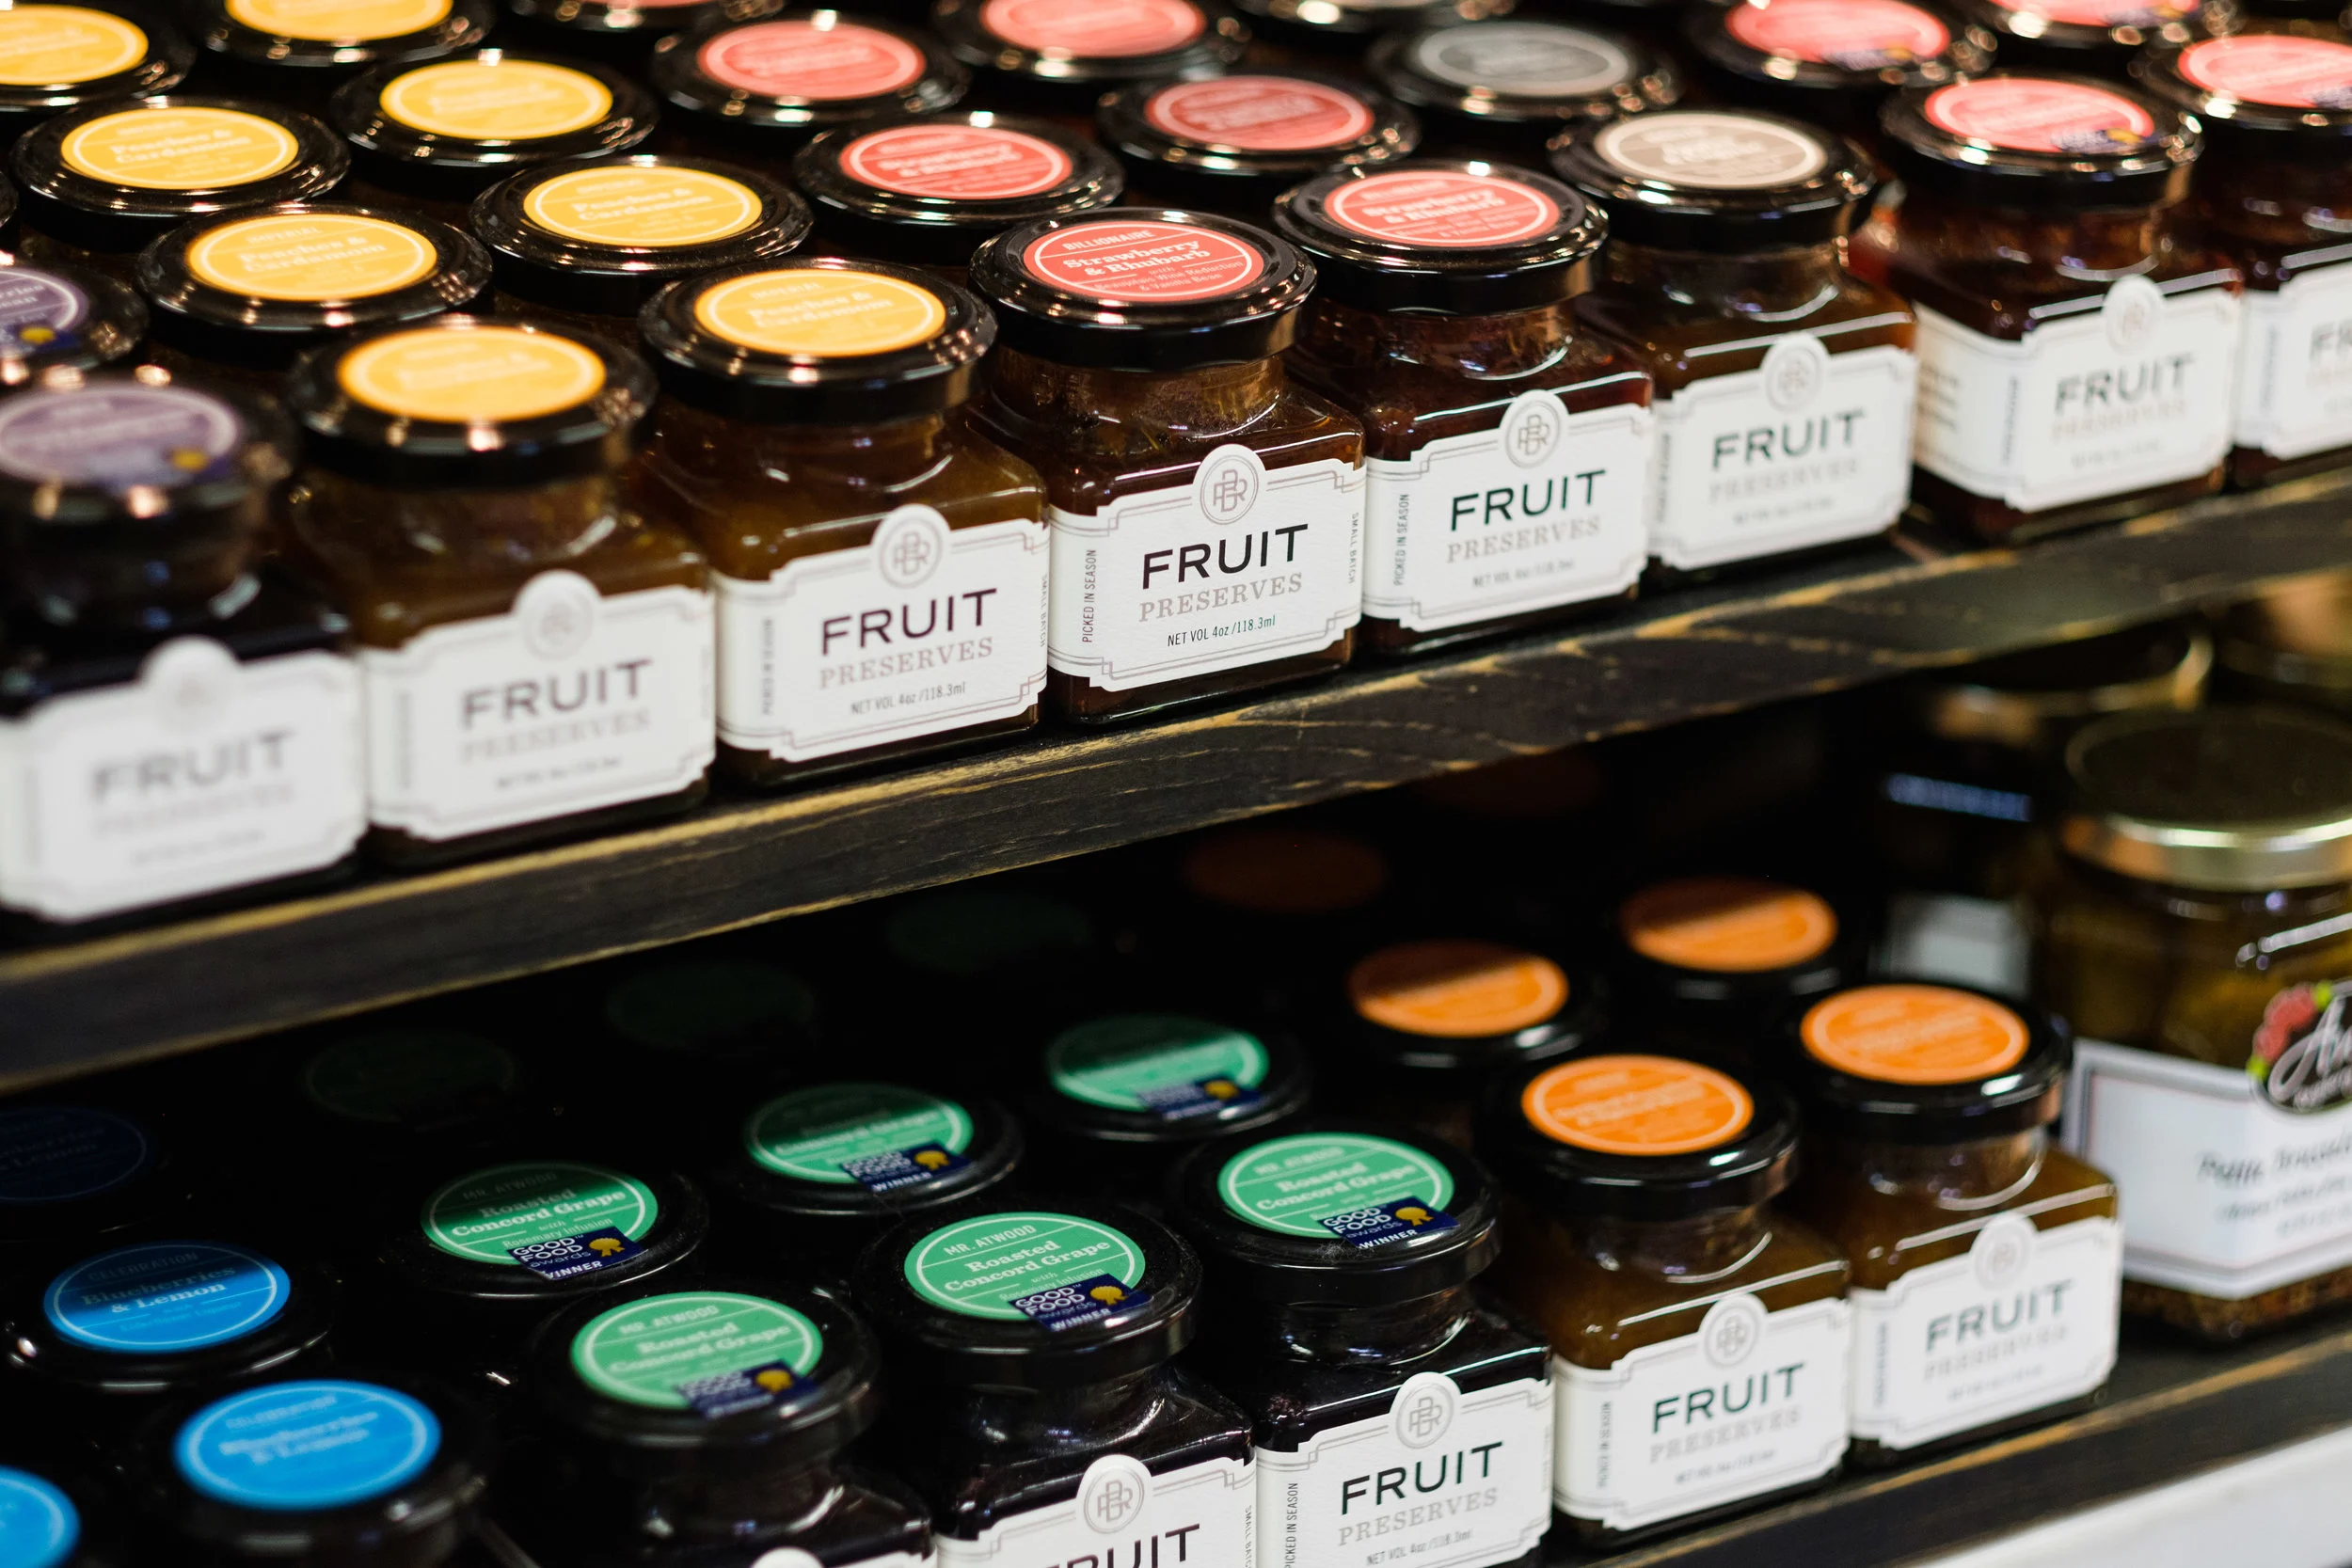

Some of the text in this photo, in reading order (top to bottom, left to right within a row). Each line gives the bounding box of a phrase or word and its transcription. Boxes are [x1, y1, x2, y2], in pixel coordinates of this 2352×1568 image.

[1062, 230, 1159, 251] BILLIONAIRE
[1062, 239, 1201, 269] Strawberry
[1084, 249, 1211, 277] & Rhubarb
[2056, 353, 2195, 415] FRUIT
[1713, 407, 1866, 469] FRUIT
[1398, 494, 1409, 534] SEASON
[1451, 469, 1607, 531] FRUIT
[1142, 523, 1309, 590] FRUIT
[1447, 515, 1601, 563] PRESERVES
[1393, 549, 1406, 586] PICKED
[1082, 549, 1097, 643] PICKED IN SEASON
[1138, 572, 1304, 623] PRESERVES
[821, 587, 997, 657] FRUIT
[1168, 632, 1188, 647] NET
[1190, 627, 1210, 642] VOL
[1212, 625, 1230, 640] 4oz
[819, 637, 994, 689] PRESERVES
[461, 658, 653, 730] FRUIT
[850, 700, 873, 717] NET
[90, 726, 296, 805] FRUIT
[1256, 1164, 1417, 1211] Concord Grape
[1275, 1162, 1369, 1193] Roasted
[452, 1190, 627, 1238] Concord Grape
[479, 1188, 577, 1219] Roasted
[1323, 1206, 1382, 1227] GOOD
[977, 1224, 1038, 1249] ATWOOD
[1333, 1213, 1392, 1234] FOOD
[1359, 1228, 1419, 1249] WINNER
[513, 1237, 576, 1258] GOOD
[521, 1243, 583, 1263] FOOD
[530, 1249, 592, 1269] awards
[945, 1241, 1112, 1292] Concord Grape
[964, 1241, 1062, 1273] Roasted
[81, 1267, 236, 1307] Blueberries
[543, 1259, 603, 1280] WINNER
[111, 1283, 228, 1314] & Lemon
[1015, 1287, 1075, 1309] GOOD
[1025, 1292, 1086, 1316] FOOD
[1926, 1278, 2075, 1354] FRUIT
[1050, 1307, 1112, 1333] WINNER
[1653, 1363, 1804, 1434] FRUIT
[1341, 1441, 1502, 1515] FRUIT
[1284, 1482, 1298, 1568] PICKED IN SEASON
[1338, 1487, 1499, 1547] PRESERVES
